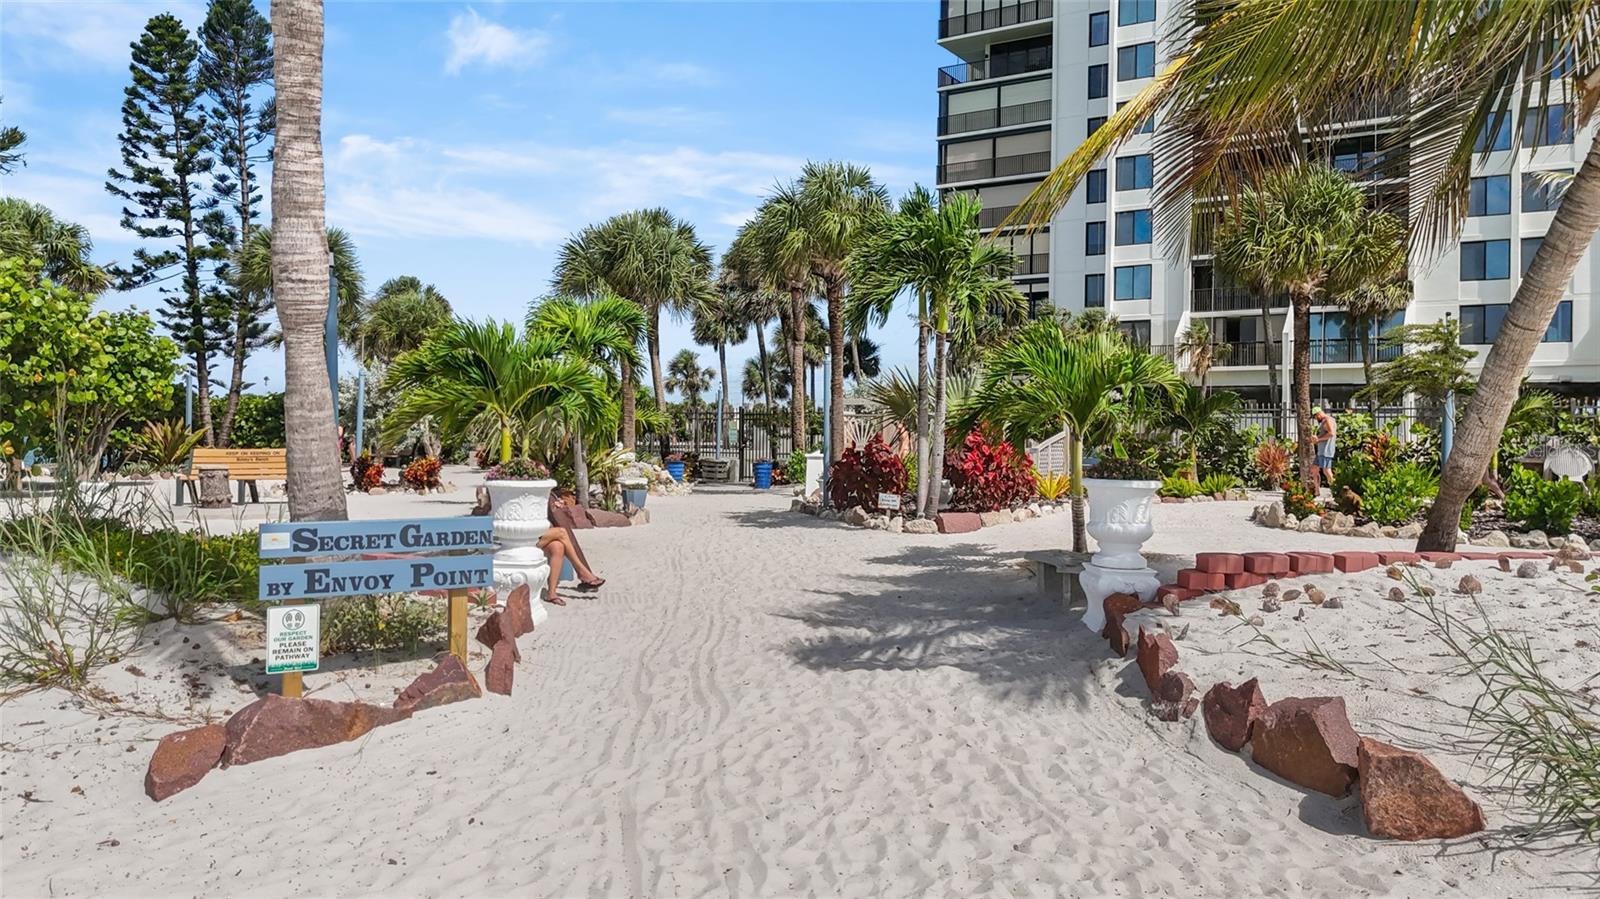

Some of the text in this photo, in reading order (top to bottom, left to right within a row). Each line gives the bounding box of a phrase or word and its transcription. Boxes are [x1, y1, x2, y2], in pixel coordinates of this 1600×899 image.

[291, 524, 493, 552] SECRET GARDEN
[266, 563, 489, 596] BY ENVOY POINT
[275, 653, 310, 661] PATHWAY
